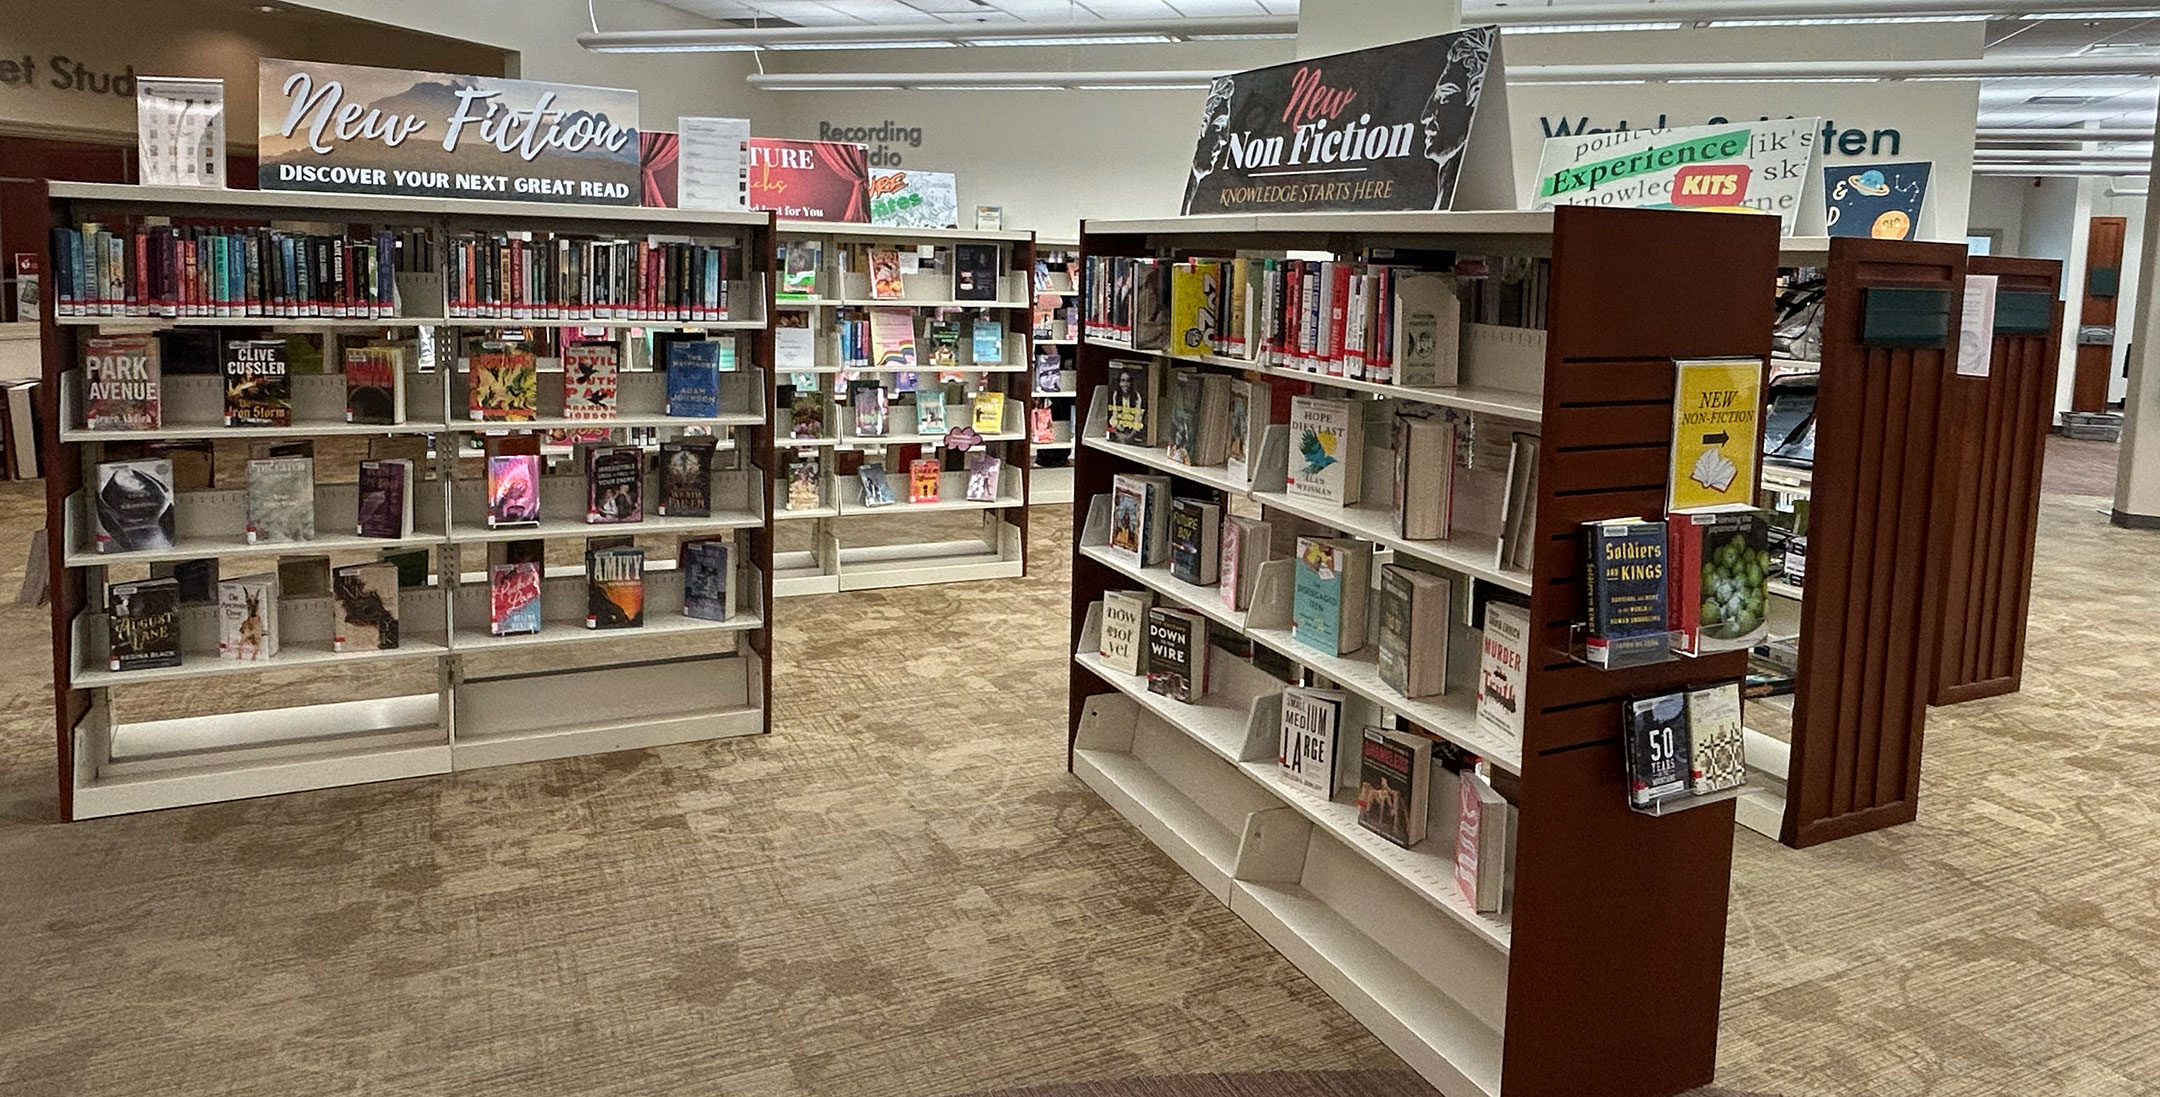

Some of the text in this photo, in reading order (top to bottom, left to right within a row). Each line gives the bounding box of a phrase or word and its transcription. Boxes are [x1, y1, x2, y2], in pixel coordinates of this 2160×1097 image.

[50, 56, 136, 97] Stud
[1282, 66, 1357, 134] New
[282, 72, 425, 154] New
[443, 85, 628, 162] Fiction
[819, 121, 922, 147] Recording
[1222, 113, 1415, 171] Non Fiction
[750, 147, 815, 170] TURE
[1550, 138, 1738, 196] Experience
[279, 163, 630, 199] DISCOVER YOUR NEXT GREAT READ
[1681, 174, 1738, 196] KITS
[1219, 179, 1394, 206] KNOWLEDGE STARTS HERE
[784, 205, 802, 217] for
[803, 206, 824, 217] You
[333, 240, 343, 256] CLIVE
[237, 348, 276, 361] CLIVE
[566, 356, 617, 366] DEVIL
[86, 356, 149, 380] PARK
[227, 361, 286, 375] CUSSLER
[89, 382, 157, 400] AVENUE
[1698, 390, 1739, 410] NEW
[253, 405, 285, 418] Storm
[1304, 411, 1332, 424] HOPE
[1681, 409, 1755, 426] NON-FICTION
[1292, 421, 1345, 438] DIES LAST
[1605, 542, 1662, 561] Soldiers
[594, 555, 642, 582] AMITY
[1621, 564, 1662, 581] KINGS
[115, 611, 173, 637] AUGUST
[1107, 606, 1136, 624] now
[132, 626, 169, 651] LANE
[1150, 624, 1187, 645] DOWN
[1151, 642, 1185, 664] WIRE
[1484, 635, 1521, 672] MURDER
[1286, 703, 1327, 737] MEDIUM
[1283, 727, 1325, 774] LARGE
[1649, 727, 1675, 761] 50
[1651, 758, 1675, 774] YEARS
